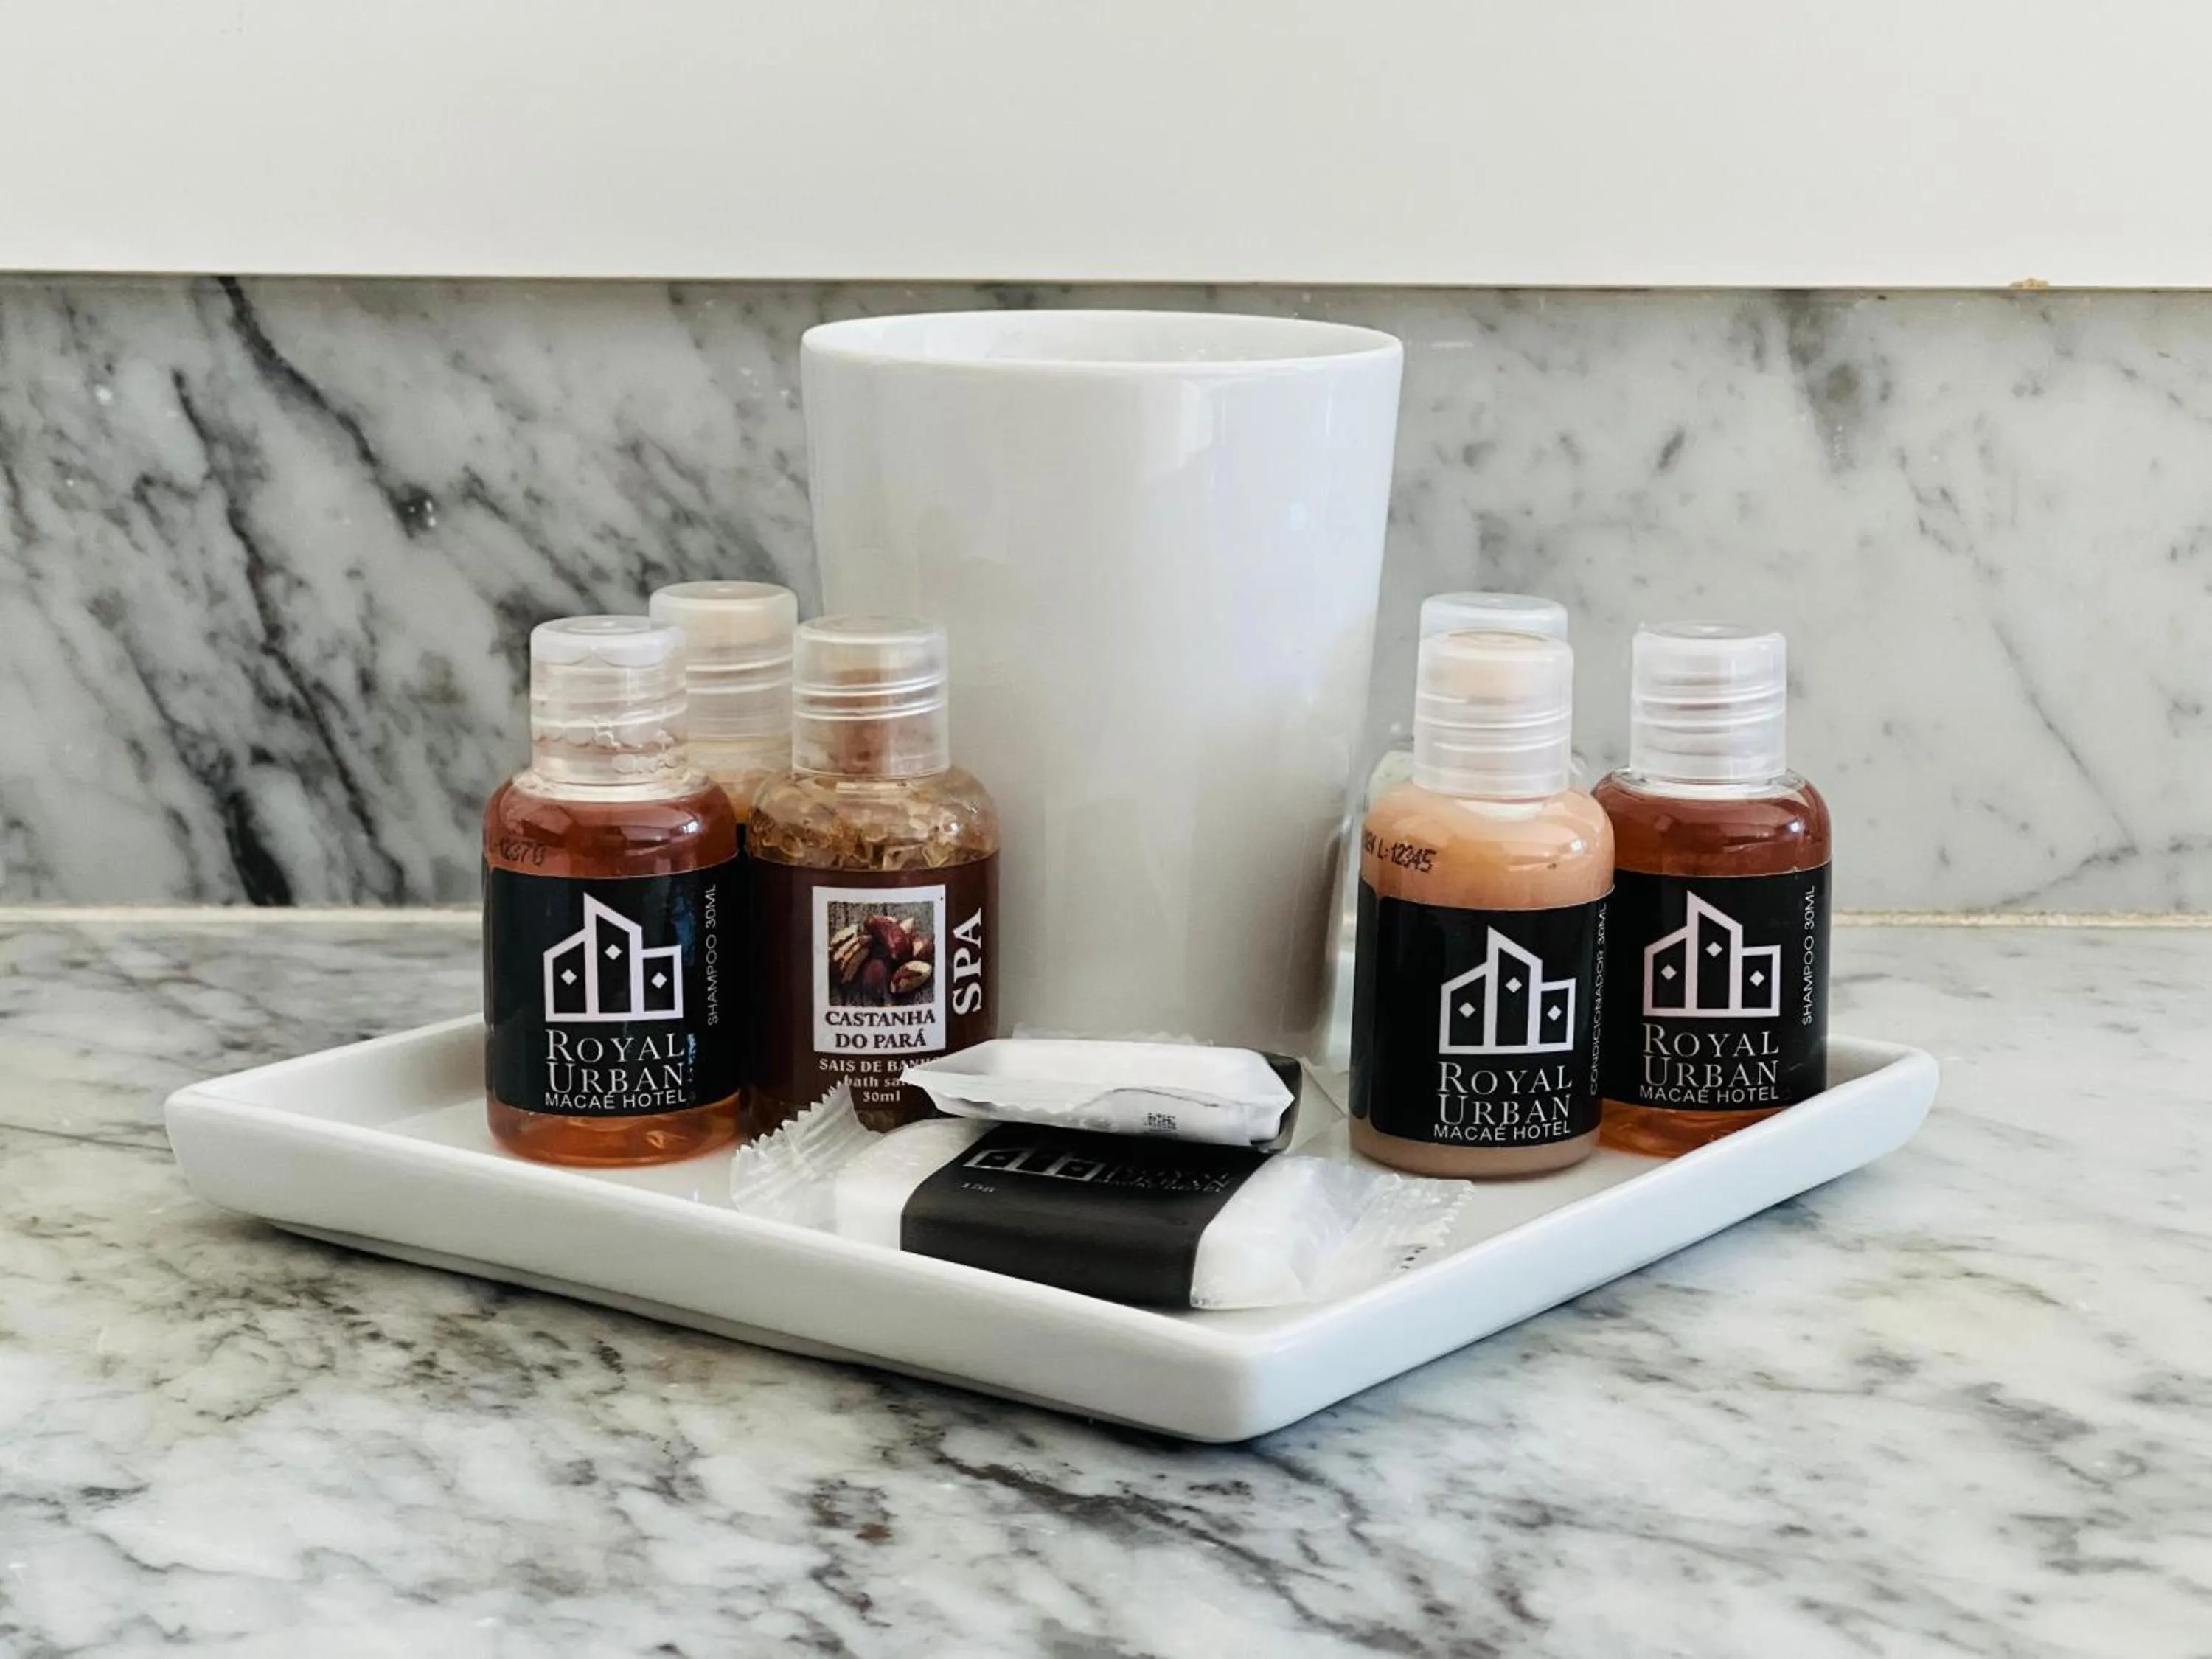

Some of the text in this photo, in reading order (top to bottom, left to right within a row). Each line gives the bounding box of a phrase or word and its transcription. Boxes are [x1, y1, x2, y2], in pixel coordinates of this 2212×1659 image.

[705, 884, 720, 1026] SHAMPOO 30ML
[952, 908, 981, 1016] SPA
[1801, 886, 1816, 1026] SHAMPOO 30ML
[1590, 902, 1607, 1096] CONDICIONADOR 30ML
[825, 1009, 936, 1027] CASTANHA
[545, 1029, 685, 1063] ROYAL
[835, 1028, 927, 1049] DO PARÁ
[1643, 1023, 1780, 1058] ROYAL
[547, 1061, 684, 1094] URBAN
[819, 1058, 855, 1072] SAIS
[860, 1060, 882, 1073] DE
[1436, 1061, 1573, 1096] ROYAL
[1643, 1055, 1781, 1088] URBAN
[544, 1089, 687, 1110] MACAÉ HOTEL
[863, 1091, 901, 1103] 30ml
[1437, 1093, 1570, 1126] URBAN
[1639, 1085, 1780, 1104] MACAÉ HOTEL
[1433, 1120, 1571, 1141] MACAÉ HOTEL
